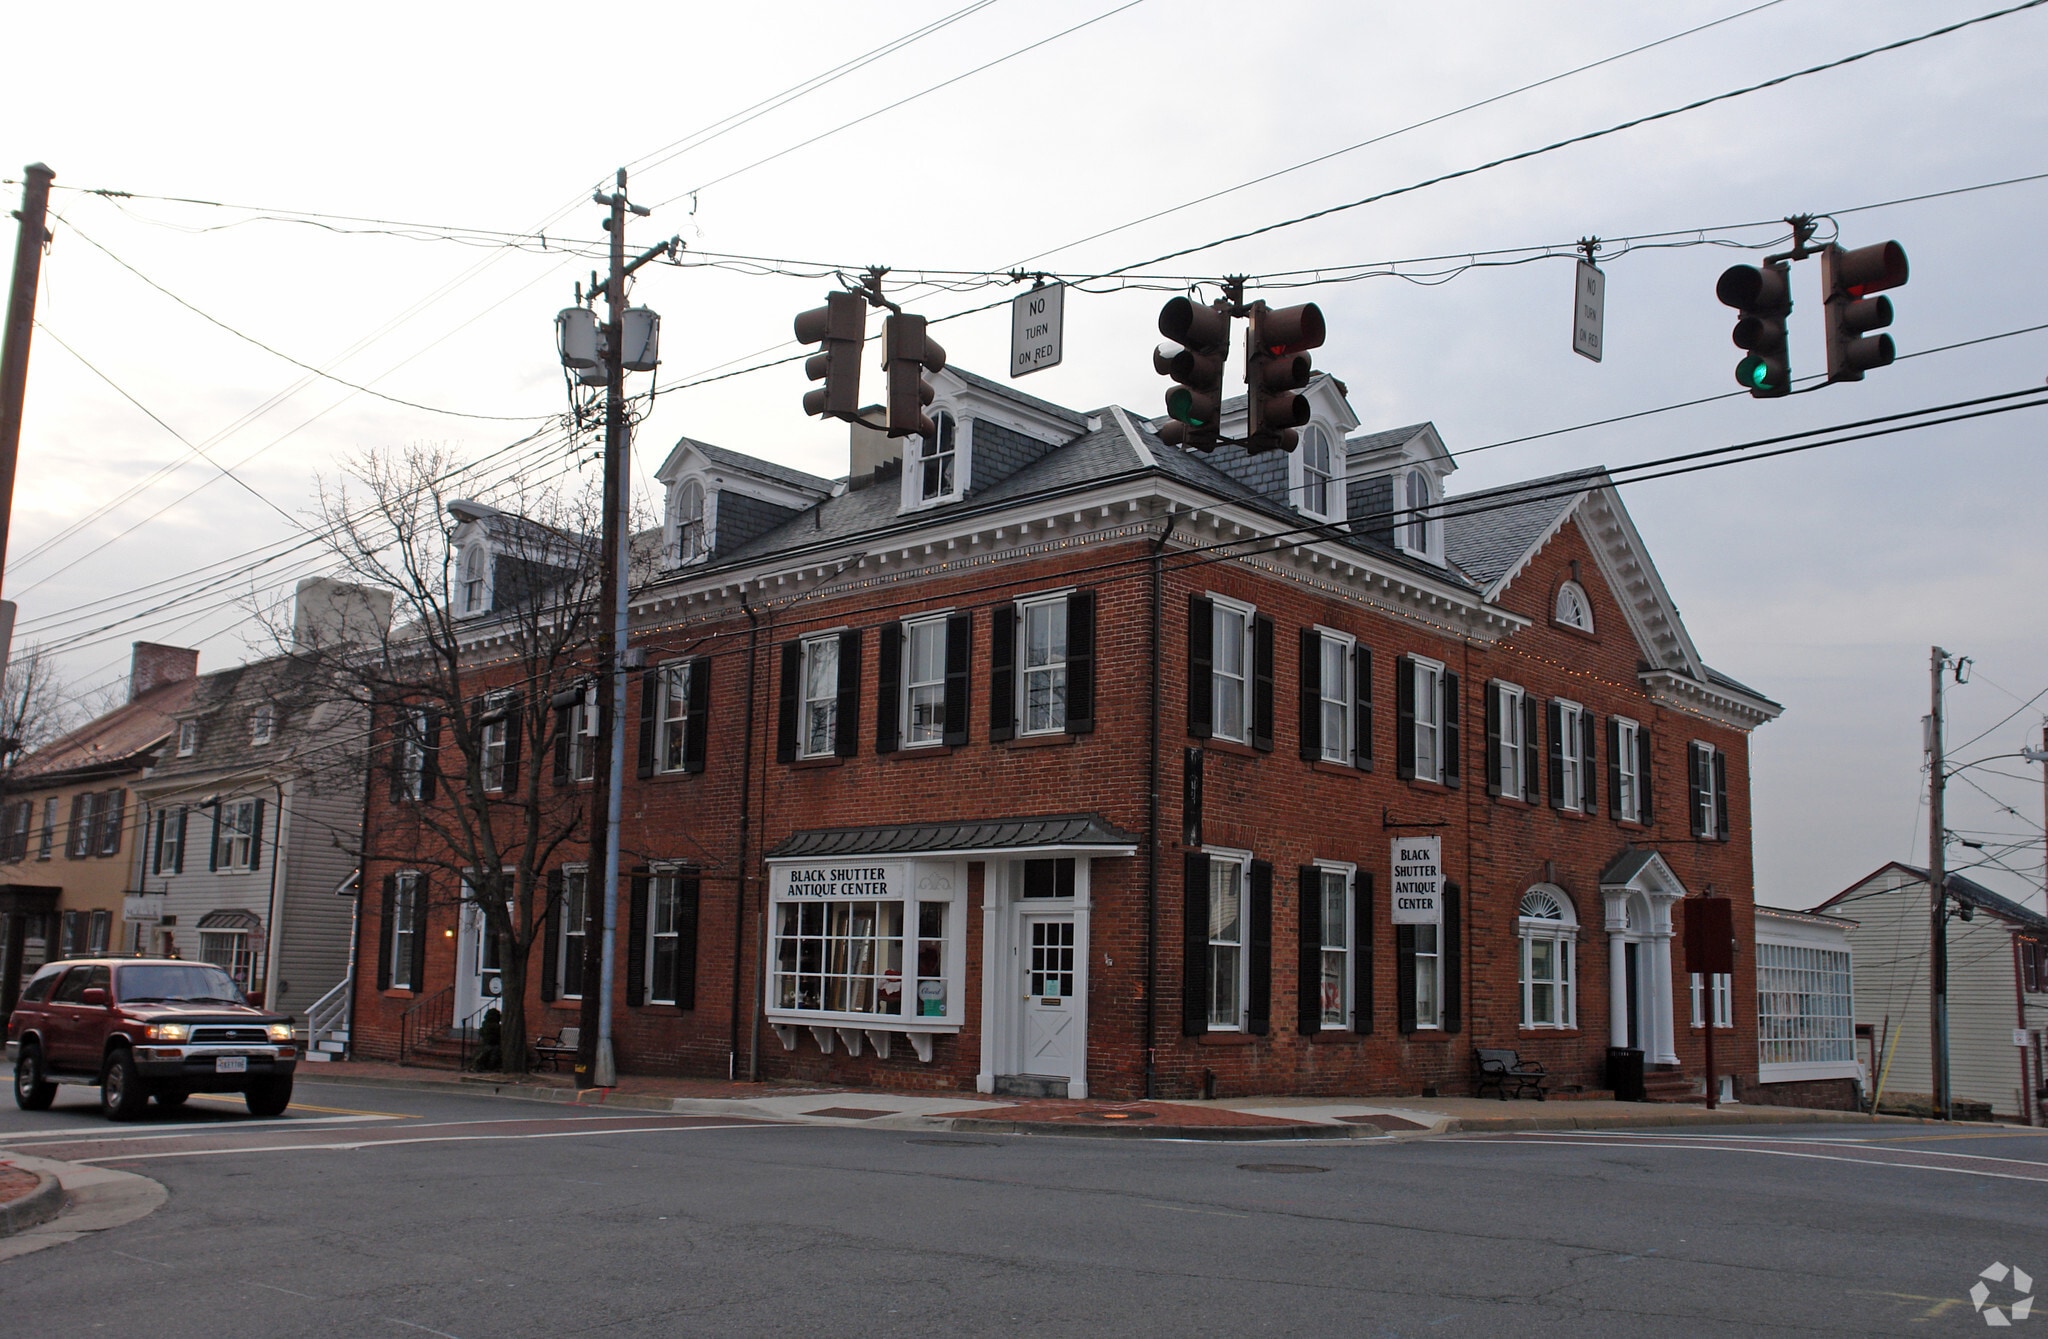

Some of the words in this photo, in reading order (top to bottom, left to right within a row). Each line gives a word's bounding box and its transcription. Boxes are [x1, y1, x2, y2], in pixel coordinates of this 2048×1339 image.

[1587, 277, 1596, 297] NO
[1029, 297, 1045, 317] NO
[1584, 304, 1597, 321] TURN
[1025, 323, 1048, 340] TURN
[1579, 328, 1587, 342] ON
[1588, 332, 1598, 348] RED
[1018, 351, 1031, 365] ON
[1035, 344, 1053, 360] RED
[1400, 849, 1430, 861] BLACK
[790, 869, 826, 882] BLACK
[830, 867, 885, 882] SHUTTER
[1394, 865, 1437, 877] SHUTTER
[787, 882, 837, 897] ANTIQUE
[841, 881, 888, 895] CENTER
[1395, 881, 1436, 895] ANTIQUE
[1398, 897, 1434, 910] CENTER
